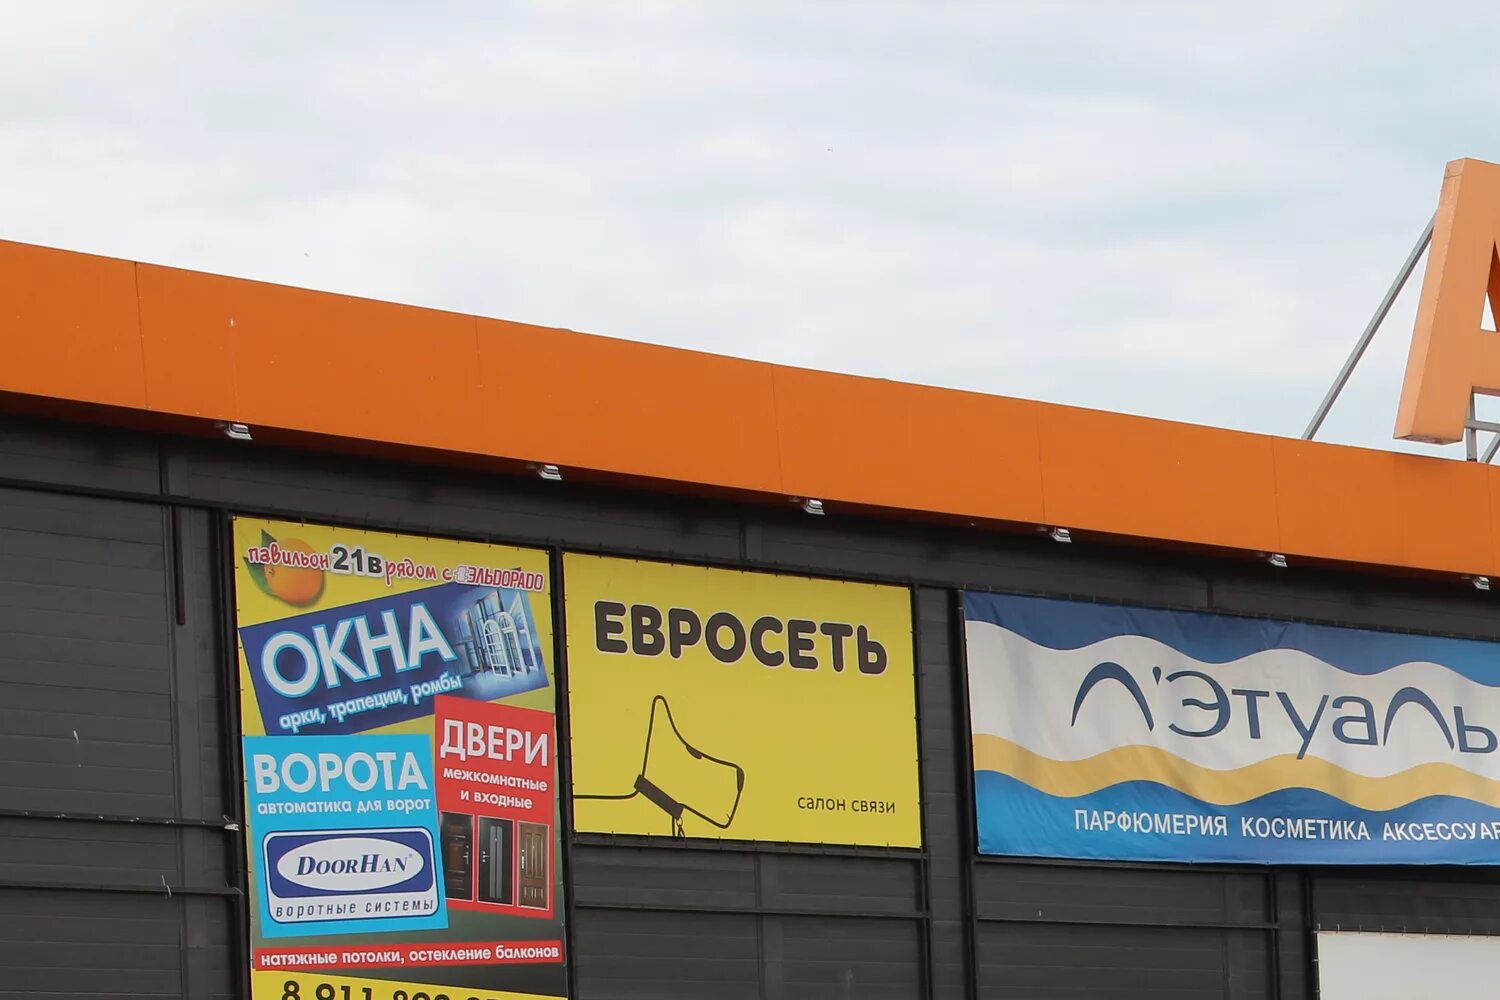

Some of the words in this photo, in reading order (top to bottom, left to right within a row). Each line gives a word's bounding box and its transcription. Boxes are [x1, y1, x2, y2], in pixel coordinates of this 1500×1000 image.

[248, 544, 329, 569] павильон
[385, 559, 436, 585] рядом
[442, 567, 453, 580] с
[261, 602, 457, 698] ОКНА
[594, 600, 888, 675] ЕВРОСЕТЬ
[280, 709, 326, 733] арки,
[327, 687, 408, 721] трапеции,
[411, 673, 462, 703] ромбы
[440, 719, 548, 766] ДВЕРИ
[253, 751, 428, 794] ВОРОТА
[443, 766, 548, 792] межкомнатные
[257, 799, 351, 815] автоматика
[357, 799, 382, 814] для
[387, 798, 431, 814] ворот
[460, 790, 470, 801] и
[474, 791, 533, 809] входные
[797, 796, 846, 811] салон
[851, 799, 896, 815] связи
[1074, 808, 1228, 837] ПАРФЮМЕРИЯ
[1241, 816, 1371, 842] КОСМЕТИКА
[276, 901, 356, 918] воротные
[365, 899, 434, 913] системы
[261, 952, 337, 967] натяжные
[342, 951, 405, 966] потолки,
[409, 948, 491, 962] остекление
[495, 945, 559, 960] балконов
